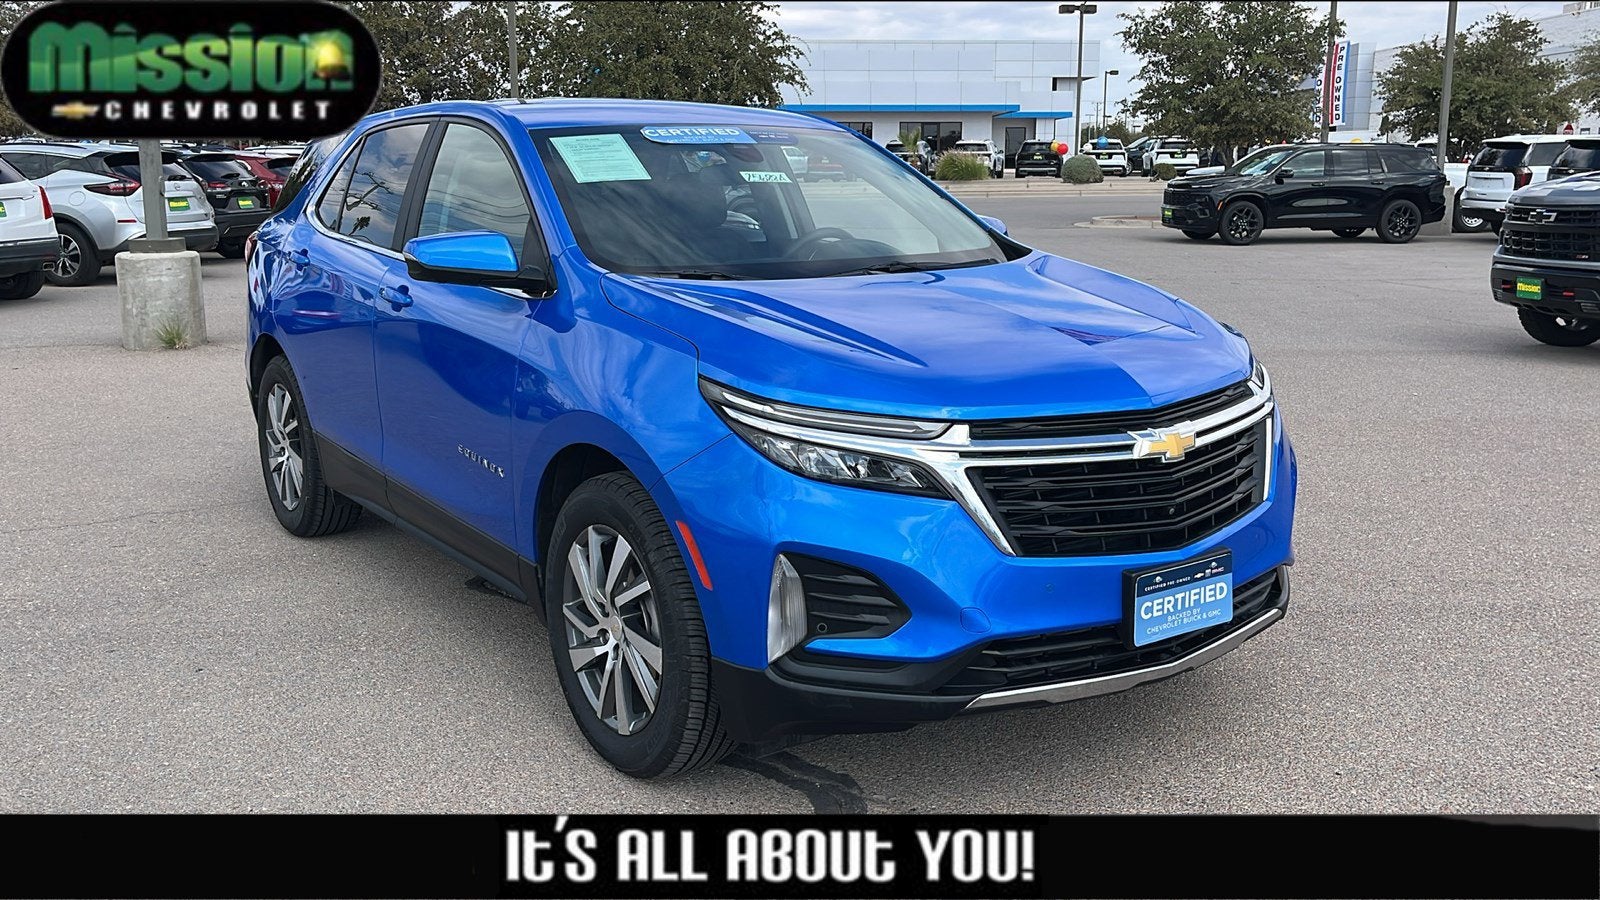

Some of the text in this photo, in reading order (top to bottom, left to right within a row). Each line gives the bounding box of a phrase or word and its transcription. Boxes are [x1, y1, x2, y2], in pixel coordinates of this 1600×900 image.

[1334, 46, 1345, 121] PRE OWNED
[644, 128, 740, 137] CERTIFIED
[457, 444, 504, 478] EQUINOX
[1140, 581, 1228, 620] CERTIFIED
[1167, 607, 1201, 622] BACKED BY
[1146, 619, 1181, 635] CHEVROLET
[1183, 613, 1202, 624] BUICK
[1207, 609, 1222, 618] GMC
